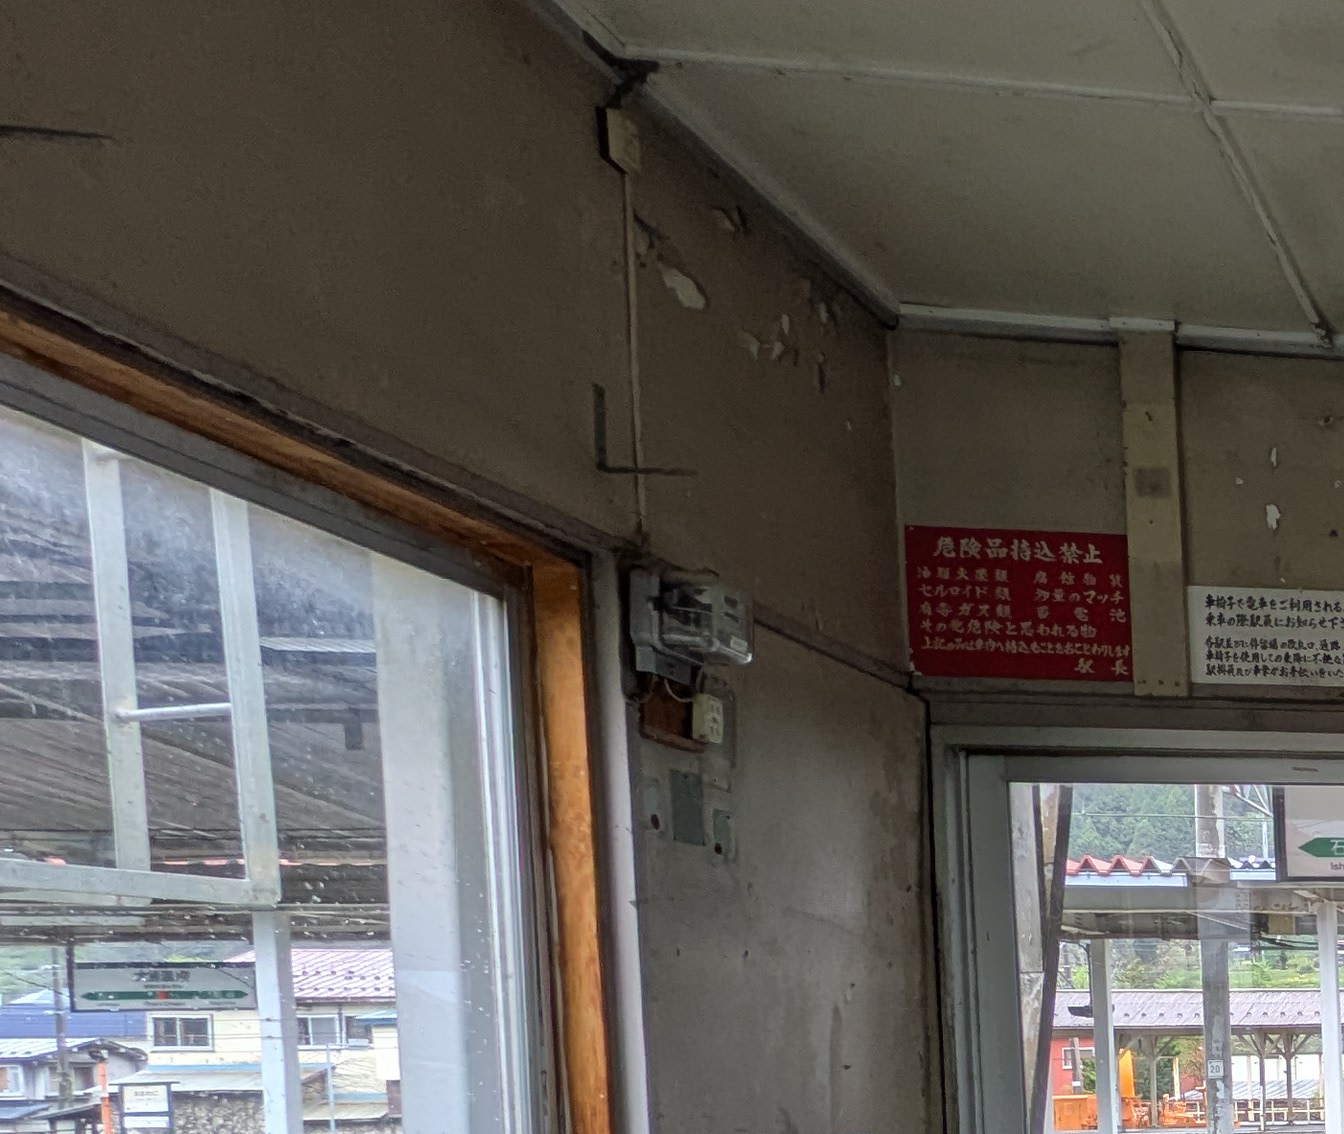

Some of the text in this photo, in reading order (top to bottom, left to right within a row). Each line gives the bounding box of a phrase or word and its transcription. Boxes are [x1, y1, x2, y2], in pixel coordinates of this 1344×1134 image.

[933, 536, 1103, 565] 危険品持込禁止
